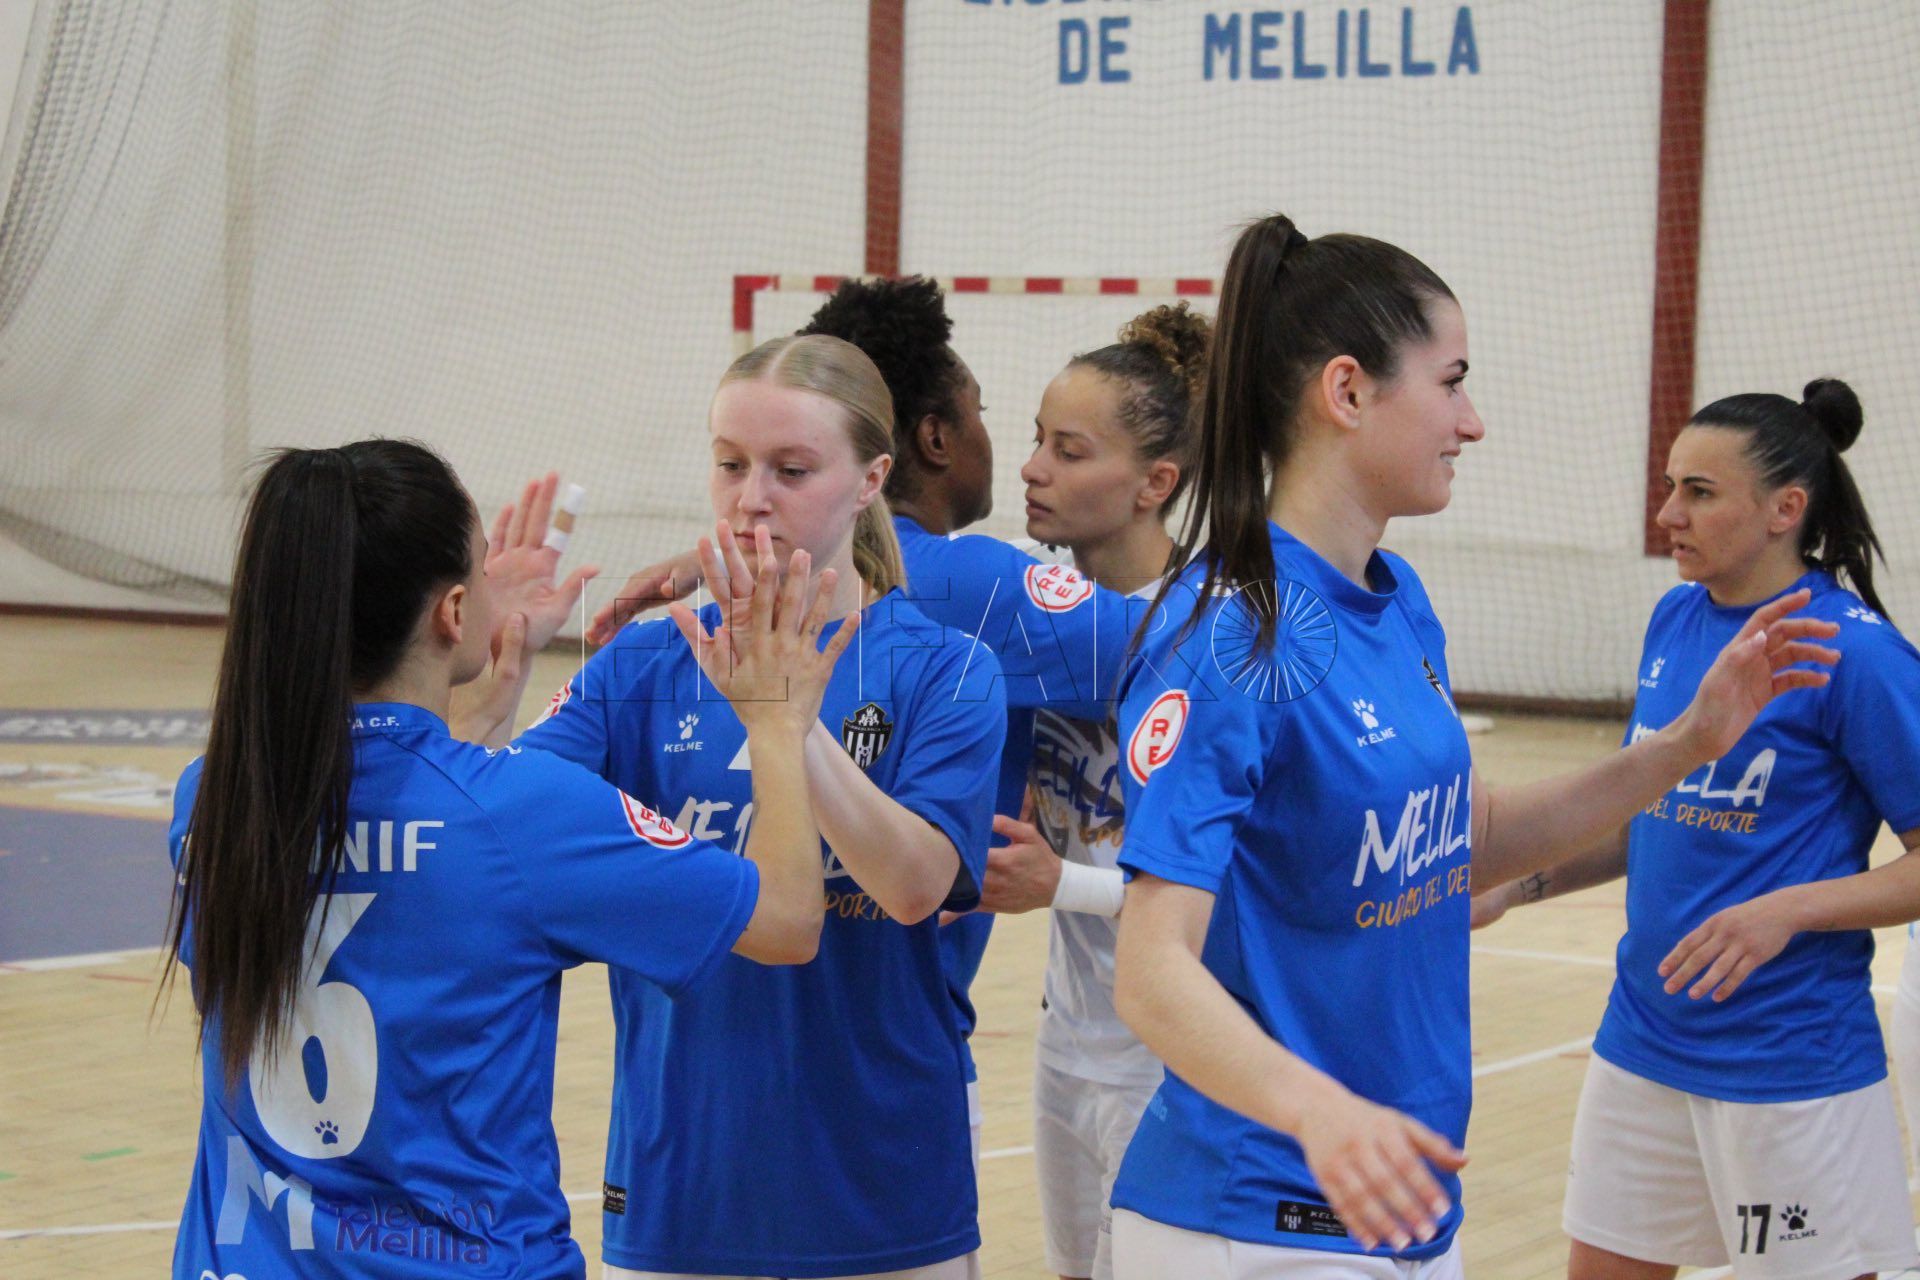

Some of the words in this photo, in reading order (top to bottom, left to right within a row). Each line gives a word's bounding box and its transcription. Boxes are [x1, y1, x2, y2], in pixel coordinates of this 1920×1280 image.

[1059, 16, 1131, 84] DE
[1203, 6, 1480, 81] MELILLA
[663, 741, 704, 753] KELME
[1356, 727, 1396, 748] KELME
[1676, 803, 1760, 834] DEPORTE
[249, 892, 378, 1160] 6
[335, 1214, 489, 1265] Melilla
[1778, 1229, 1819, 1242] KELME
